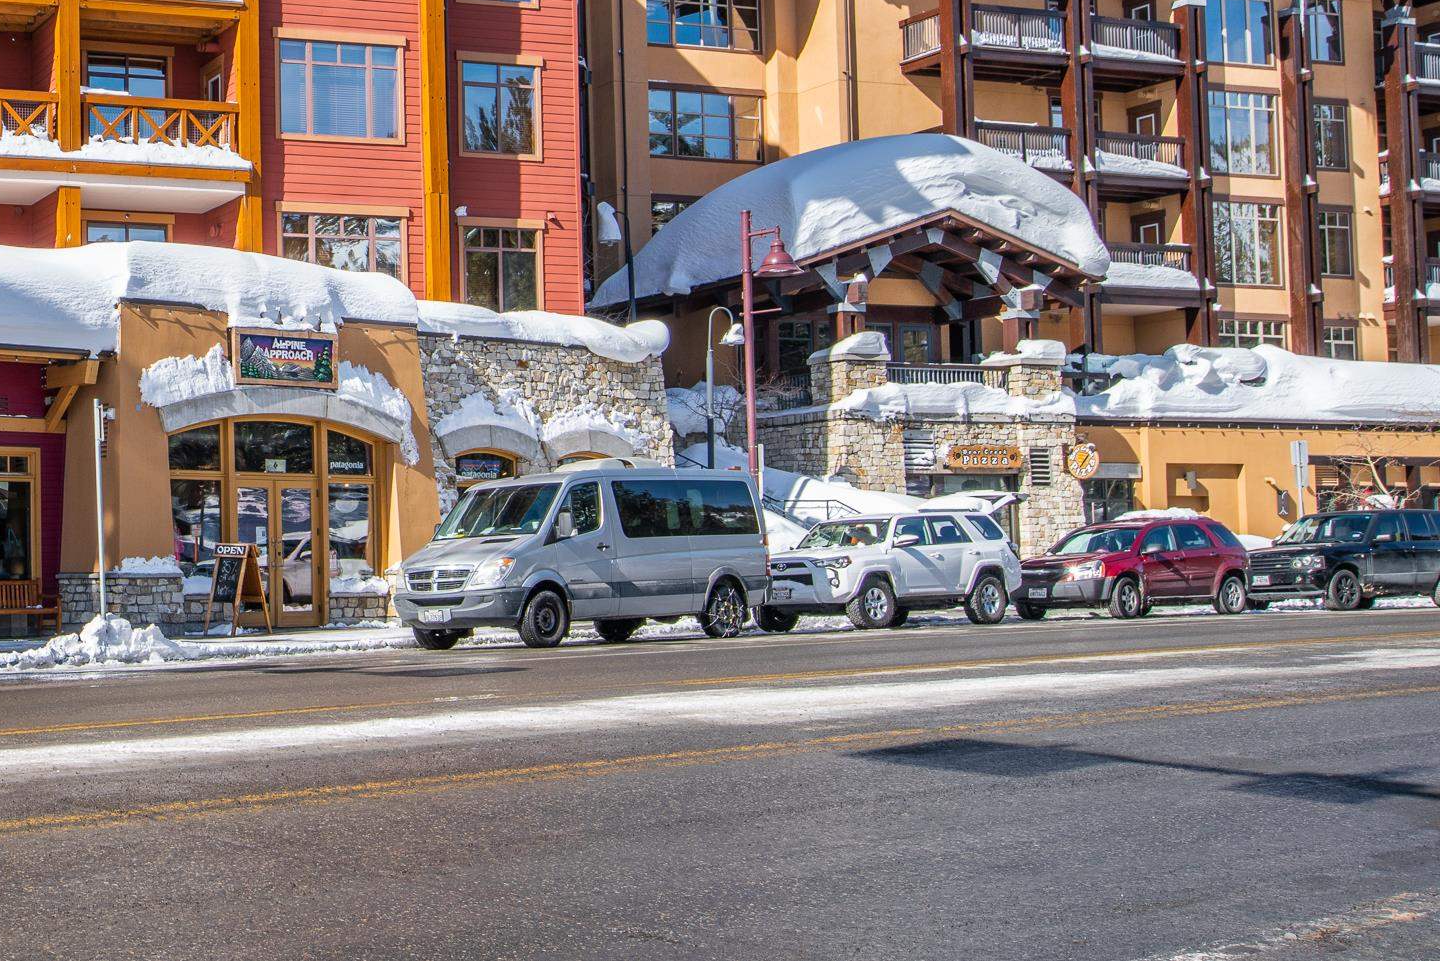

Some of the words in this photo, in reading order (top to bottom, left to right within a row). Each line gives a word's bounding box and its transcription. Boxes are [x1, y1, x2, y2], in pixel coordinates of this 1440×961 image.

[272, 338, 306, 350] ALPINE
[264, 347, 314, 360] APPROACH
[962, 455, 1009, 465] Pizza
[329, 461, 364, 470] patagonia
[217, 546, 245, 555] OPEN
